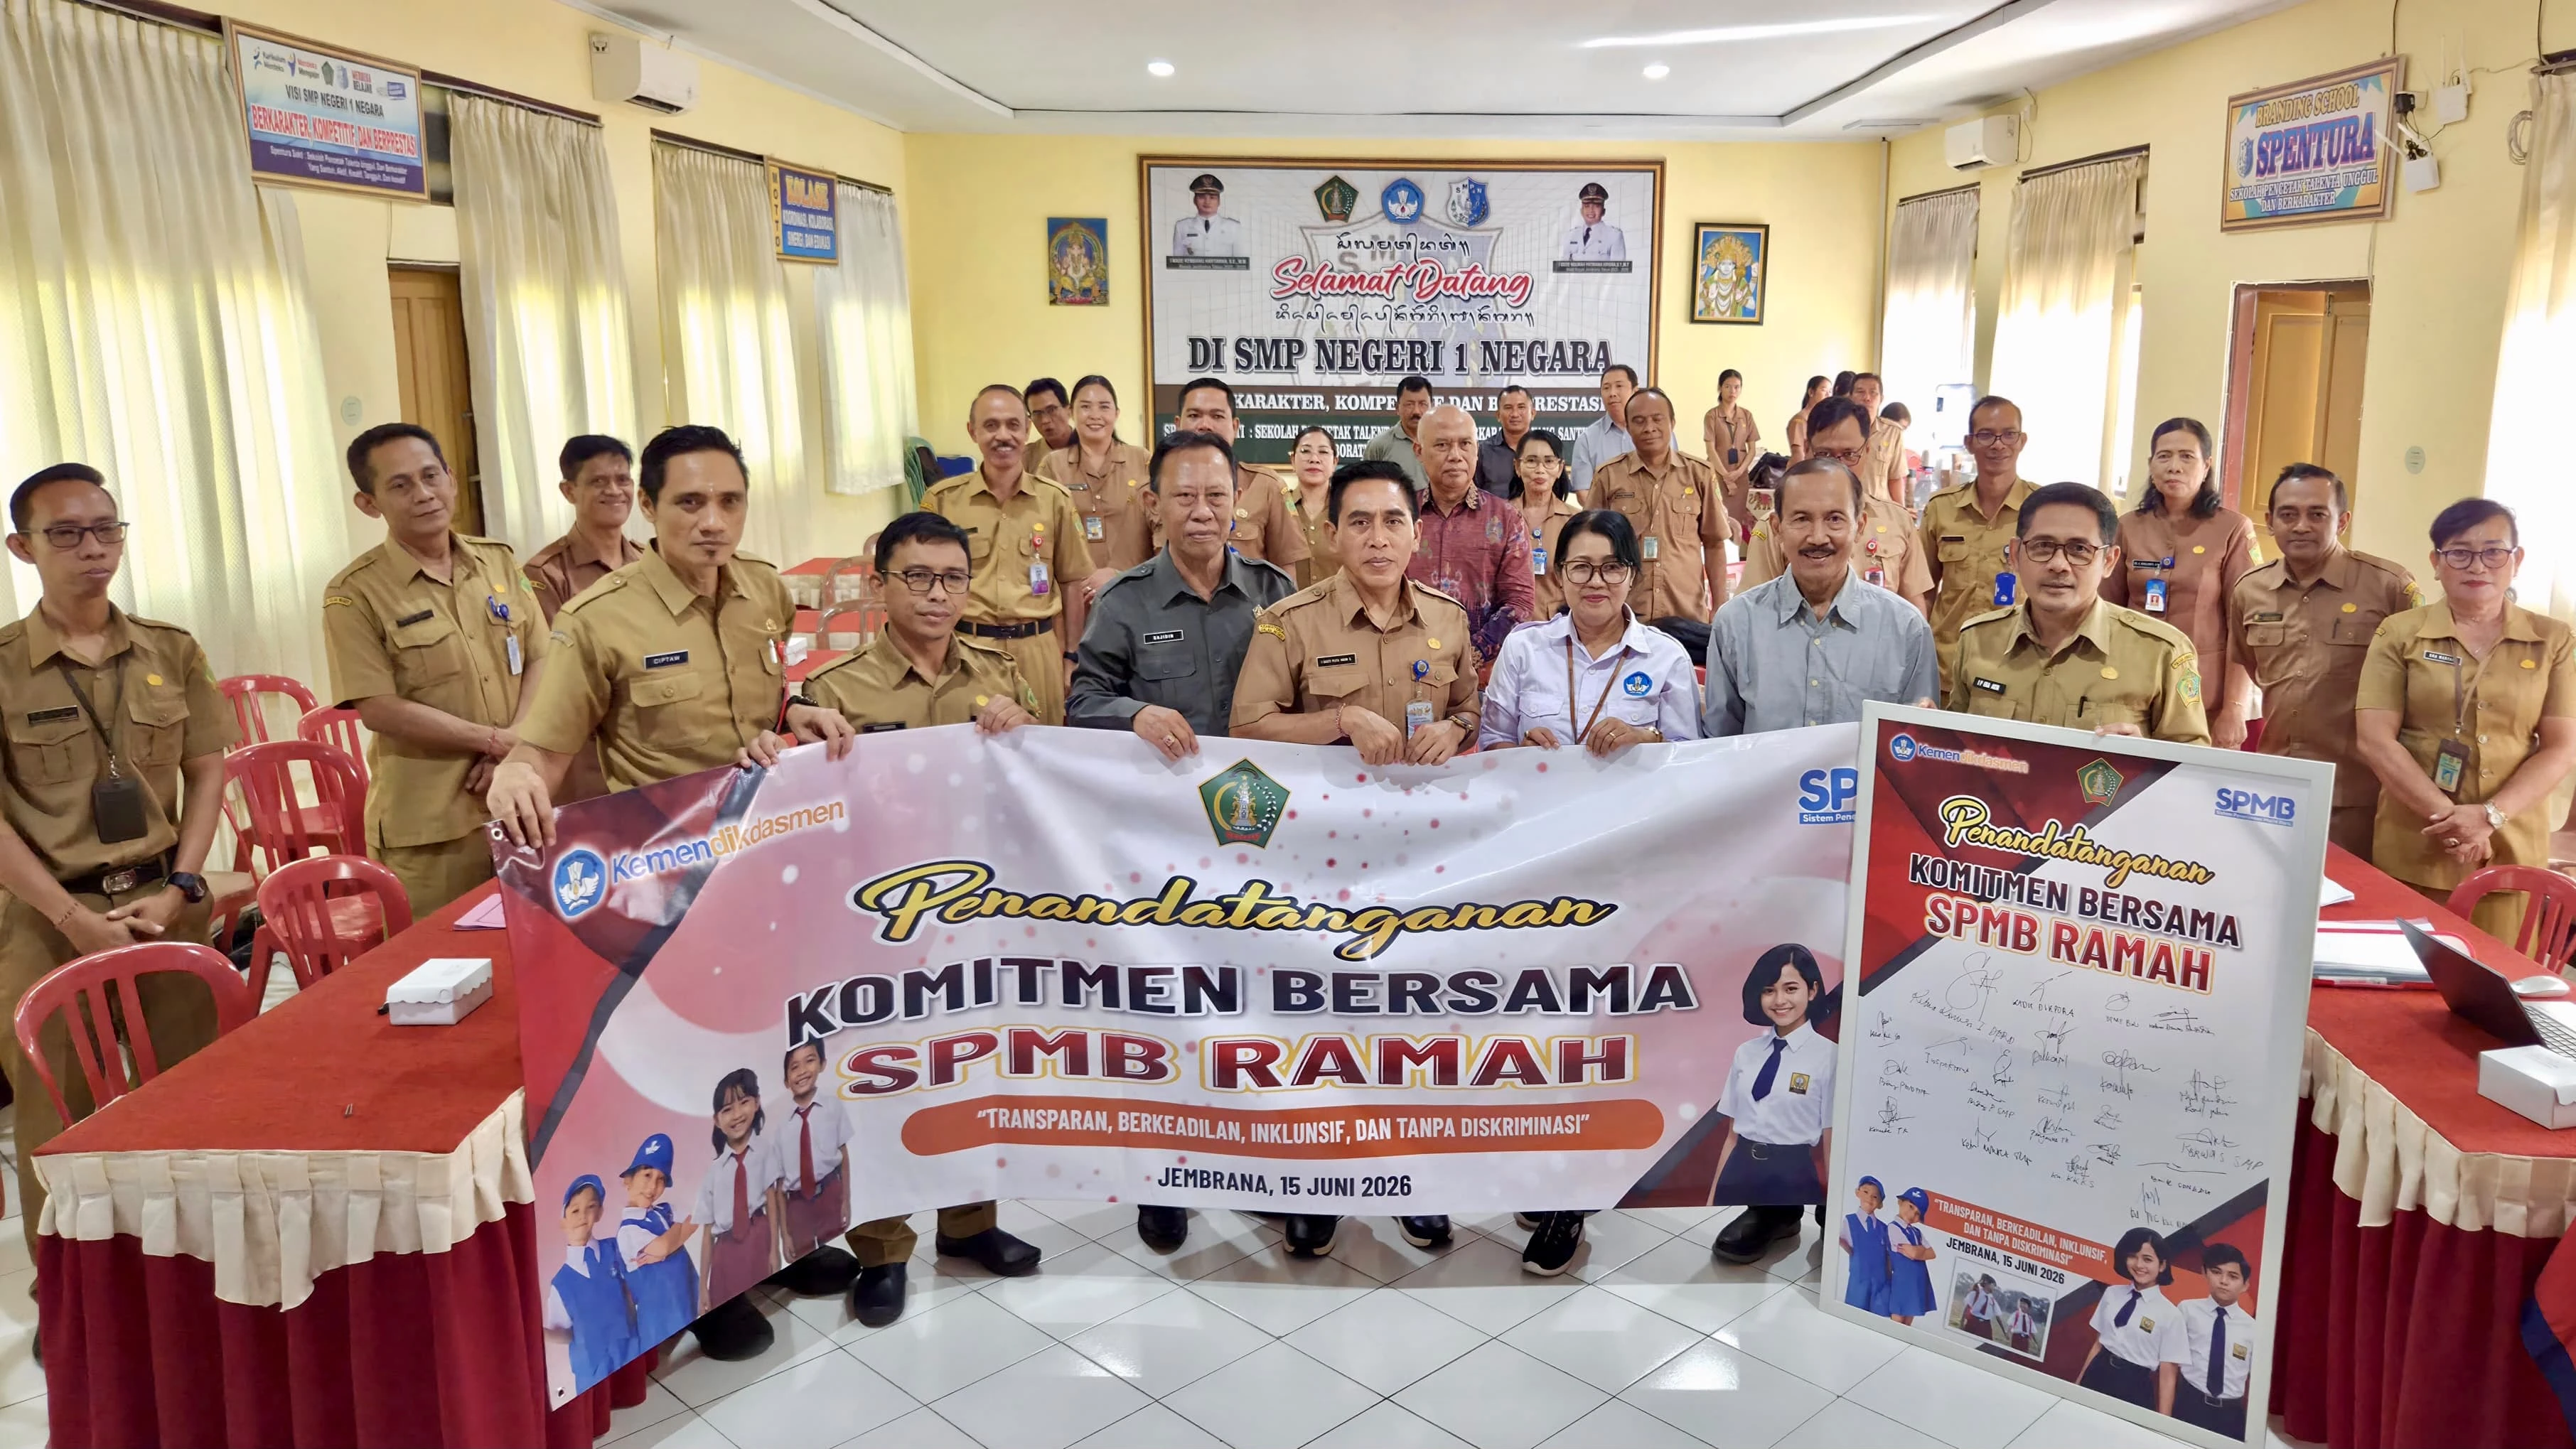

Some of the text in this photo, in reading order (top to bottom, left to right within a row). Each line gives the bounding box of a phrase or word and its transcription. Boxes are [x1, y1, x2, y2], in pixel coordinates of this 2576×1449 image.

[286, 85, 385, 118] VISI SMP NEGERI 1 NEGARA
[2255, 84, 2360, 127] BRANDING SCHOOL
[358, 126, 372, 147] DAN
[373, 129, 417, 156] BERPRESTASI
[2255, 112, 2376, 178] SPENTURA
[2230, 168, 2378, 202] SEKOLAH PENCETAK TALENTA UNGGUL
[2261, 191, 2336, 212] DAN BERKARAKTER
[1271, 257, 1534, 307] Selamat Datang
[1187, 335, 1614, 376] DI SMP NEGERI 1 NEGARA
[1234, 394, 1331, 412] KARAKTER,
[1449, 395, 1484, 411] DAN
[1918, 742, 2030, 775] Kemendikdasmen
[1798, 767, 1858, 812] SP
[2216, 787, 2295, 820] SPMB
[611, 800, 845, 883] Kemendikdasmen
[1940, 796, 2215, 888] Penandatanganan
[853, 859, 1619, 961] Penandatanganan
[1911, 854, 2241, 949] KOMITMEN BERSAMA
[1926, 893, 2216, 995] SPMB RAMAH
[785, 957, 1700, 1051] KOMITMEN BERSAMA
[837, 1024, 1635, 1099] SPMB RAMAH
[1117, 1111, 1246, 1143] BERKEADILAN,
[1250, 1120, 1351, 1146] INKLUNSIF,
[1356, 1119, 1392, 1143] DAN
[1396, 1118, 1456, 1138] TANPA
[1157, 1166, 1412, 1197] JEMBRANA, 15 JUNI 2026
[1964, 1222, 1981, 1238] DAN
[1983, 1227, 2009, 1247] TANPA
[1996, 1218, 2057, 1249] BERKEADILAN,
[2059, 1237, 2108, 1265] INKLUNSIF,
[1946, 1237, 2066, 1285] JEMBRANA, 15 JUNI 2026
